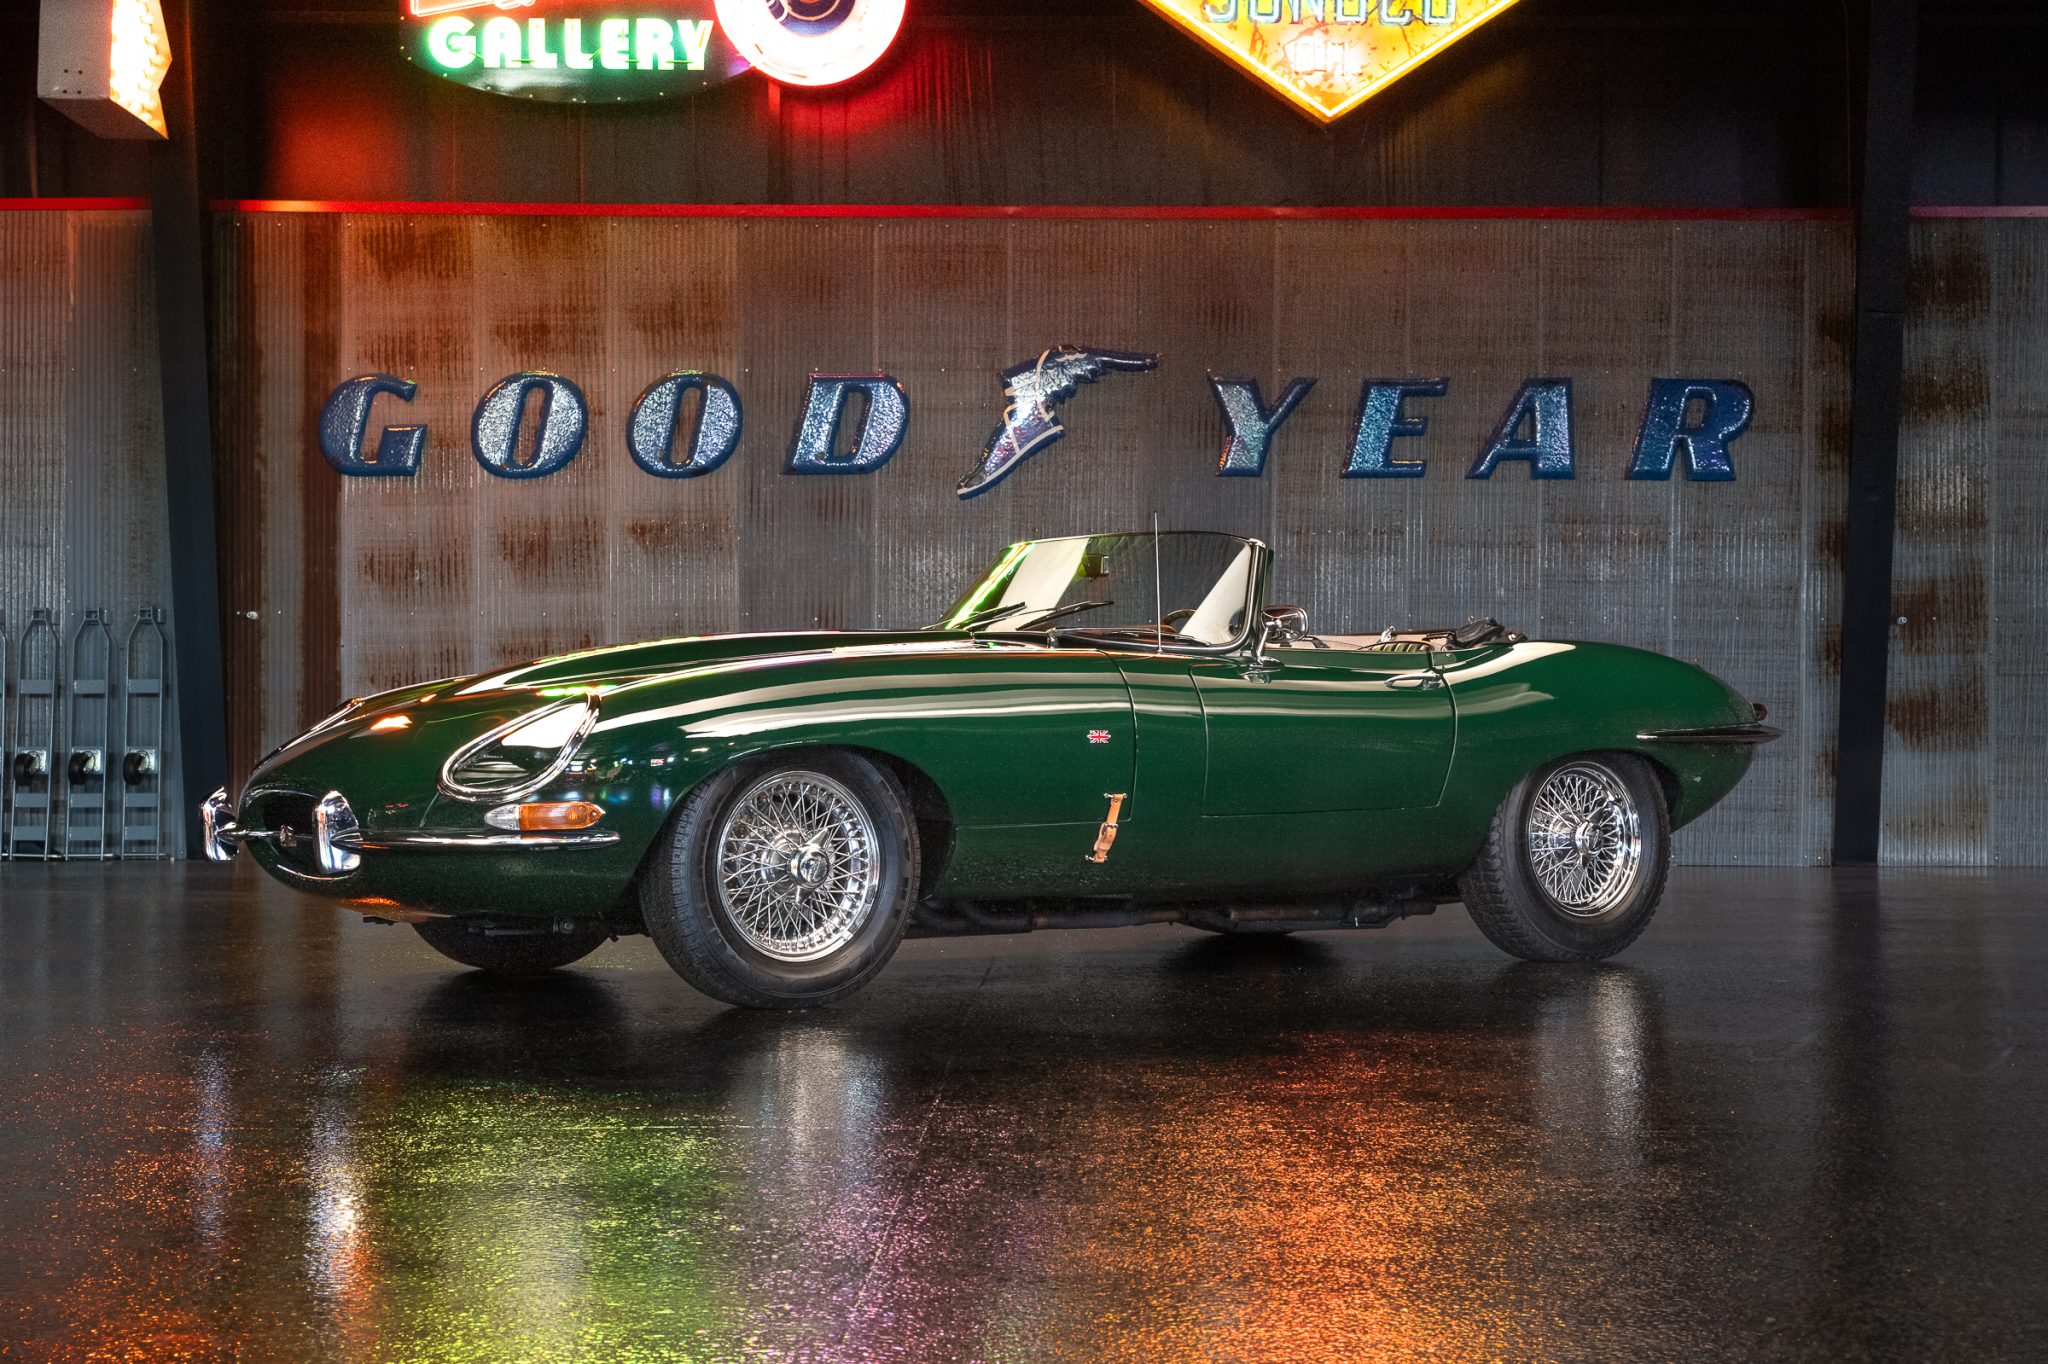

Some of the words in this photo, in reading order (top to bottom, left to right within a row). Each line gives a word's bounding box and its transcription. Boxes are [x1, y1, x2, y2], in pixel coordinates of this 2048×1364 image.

[428, 15, 714, 71] GALLERY
[319, 370, 911, 479] GOOD
[1207, 376, 1756, 481] YEAR
